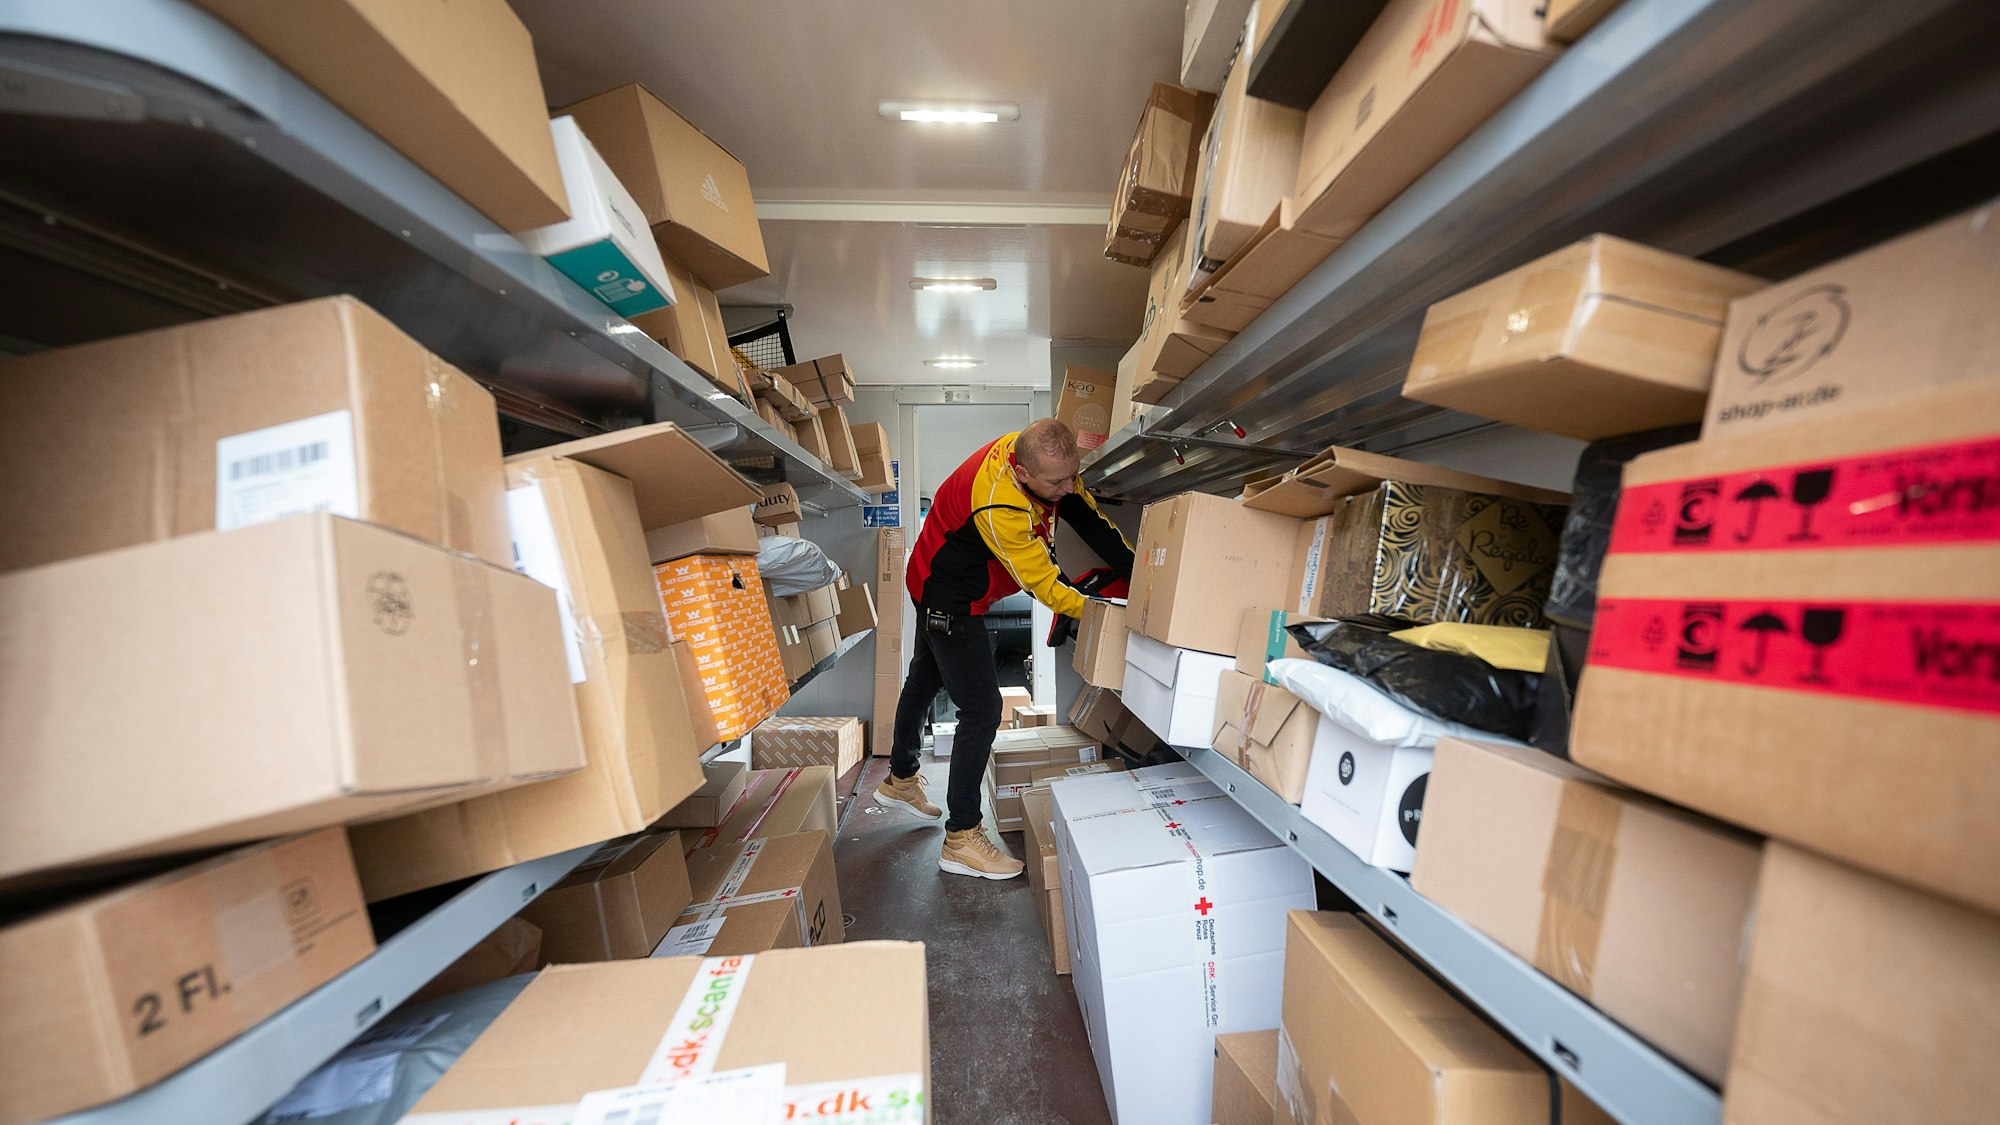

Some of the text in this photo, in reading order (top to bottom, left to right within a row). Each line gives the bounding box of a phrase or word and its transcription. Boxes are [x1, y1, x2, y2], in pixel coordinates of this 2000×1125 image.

[1469, 529, 1547, 572] Regalo
[665, 572, 704, 585] VET-CONCEPT
[670, 593, 709, 607] VET-CONCEPT
[676, 615, 715, 630] VET-CONCEPT
[698, 659, 725, 671] CONCEPT
[704, 681, 730, 693] CONCEPT
[1195, 920, 1203, 941] Kreuz
[1208, 918, 1216, 955] Deutsches
[1207, 961, 1216, 979] DRK
[132, 962, 232, 1037] 2 Fl.
[1209, 984, 1217, 1013] Service
